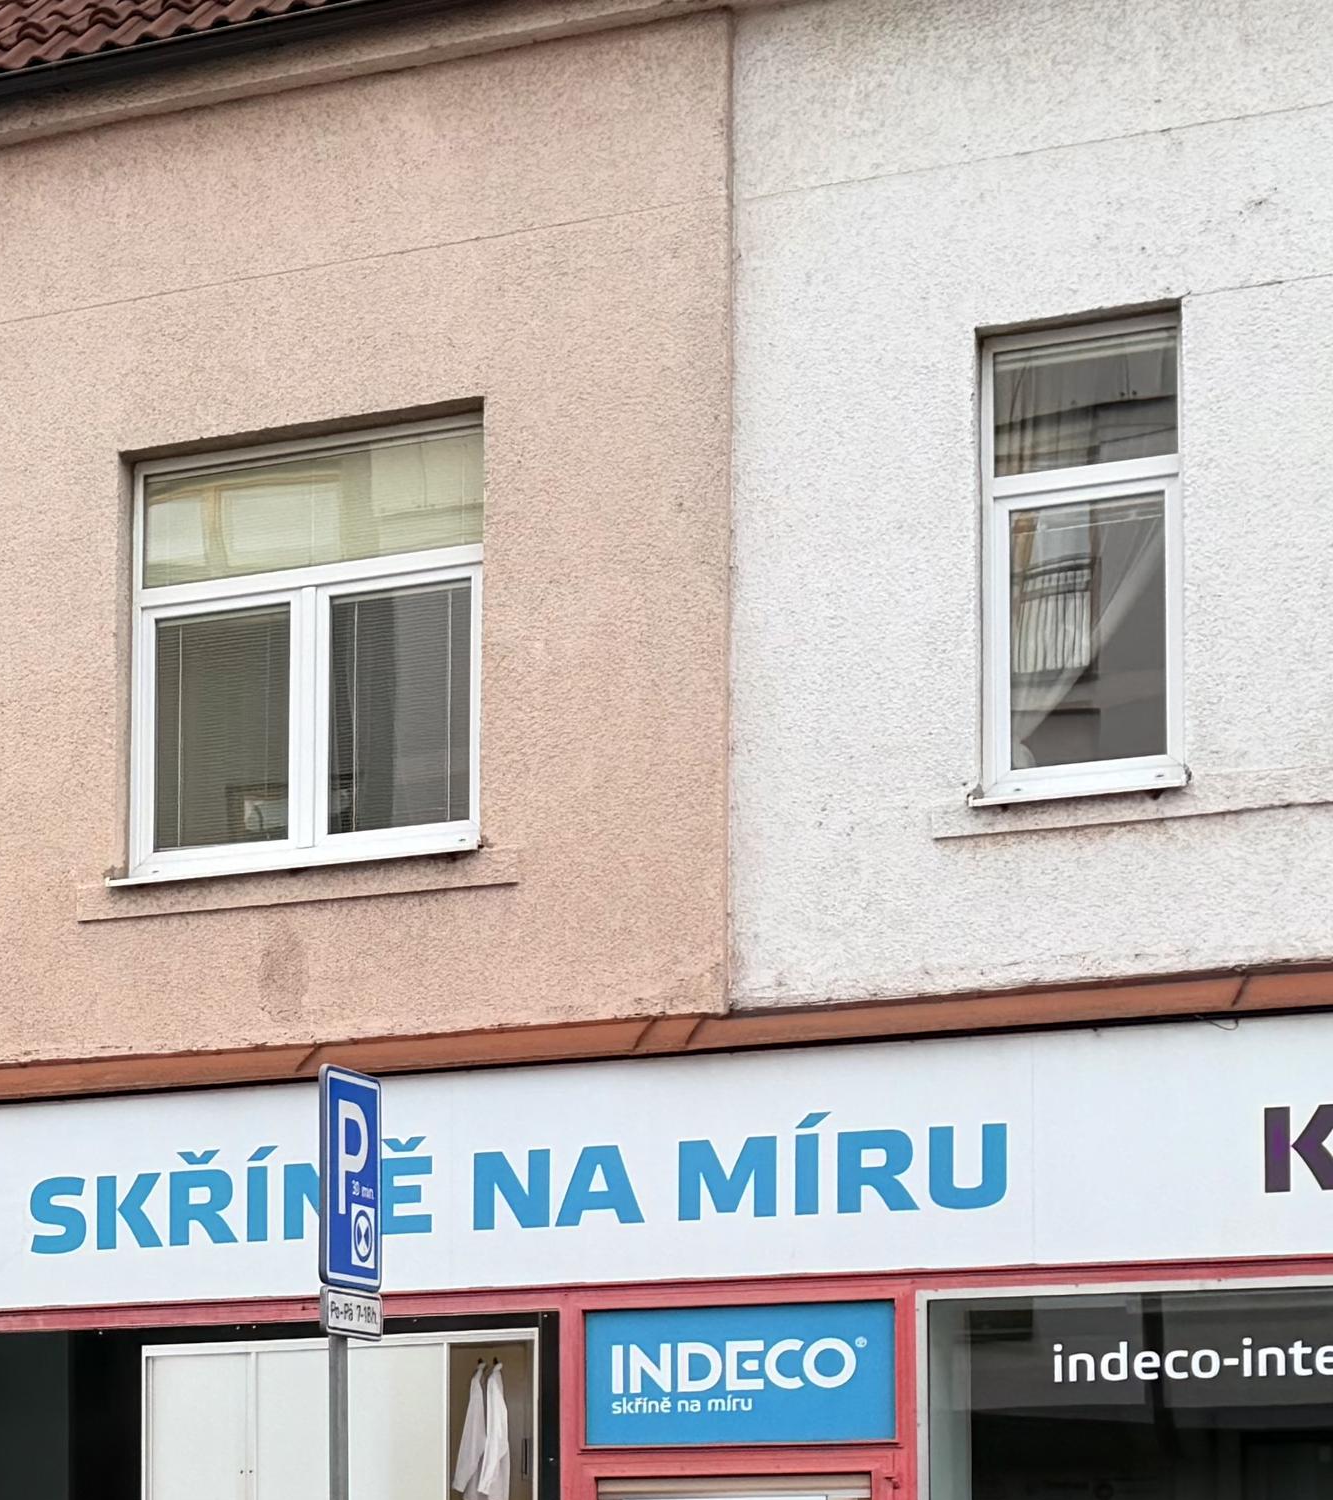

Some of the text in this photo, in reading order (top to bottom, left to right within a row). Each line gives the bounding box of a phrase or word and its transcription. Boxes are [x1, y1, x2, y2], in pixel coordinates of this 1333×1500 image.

[338, 1099, 369, 1215] P
[472, 1144, 645, 1231] NA
[677, 1110, 1010, 1222] MÍRU
[611, 1395, 753, 1415] skříně na míru
